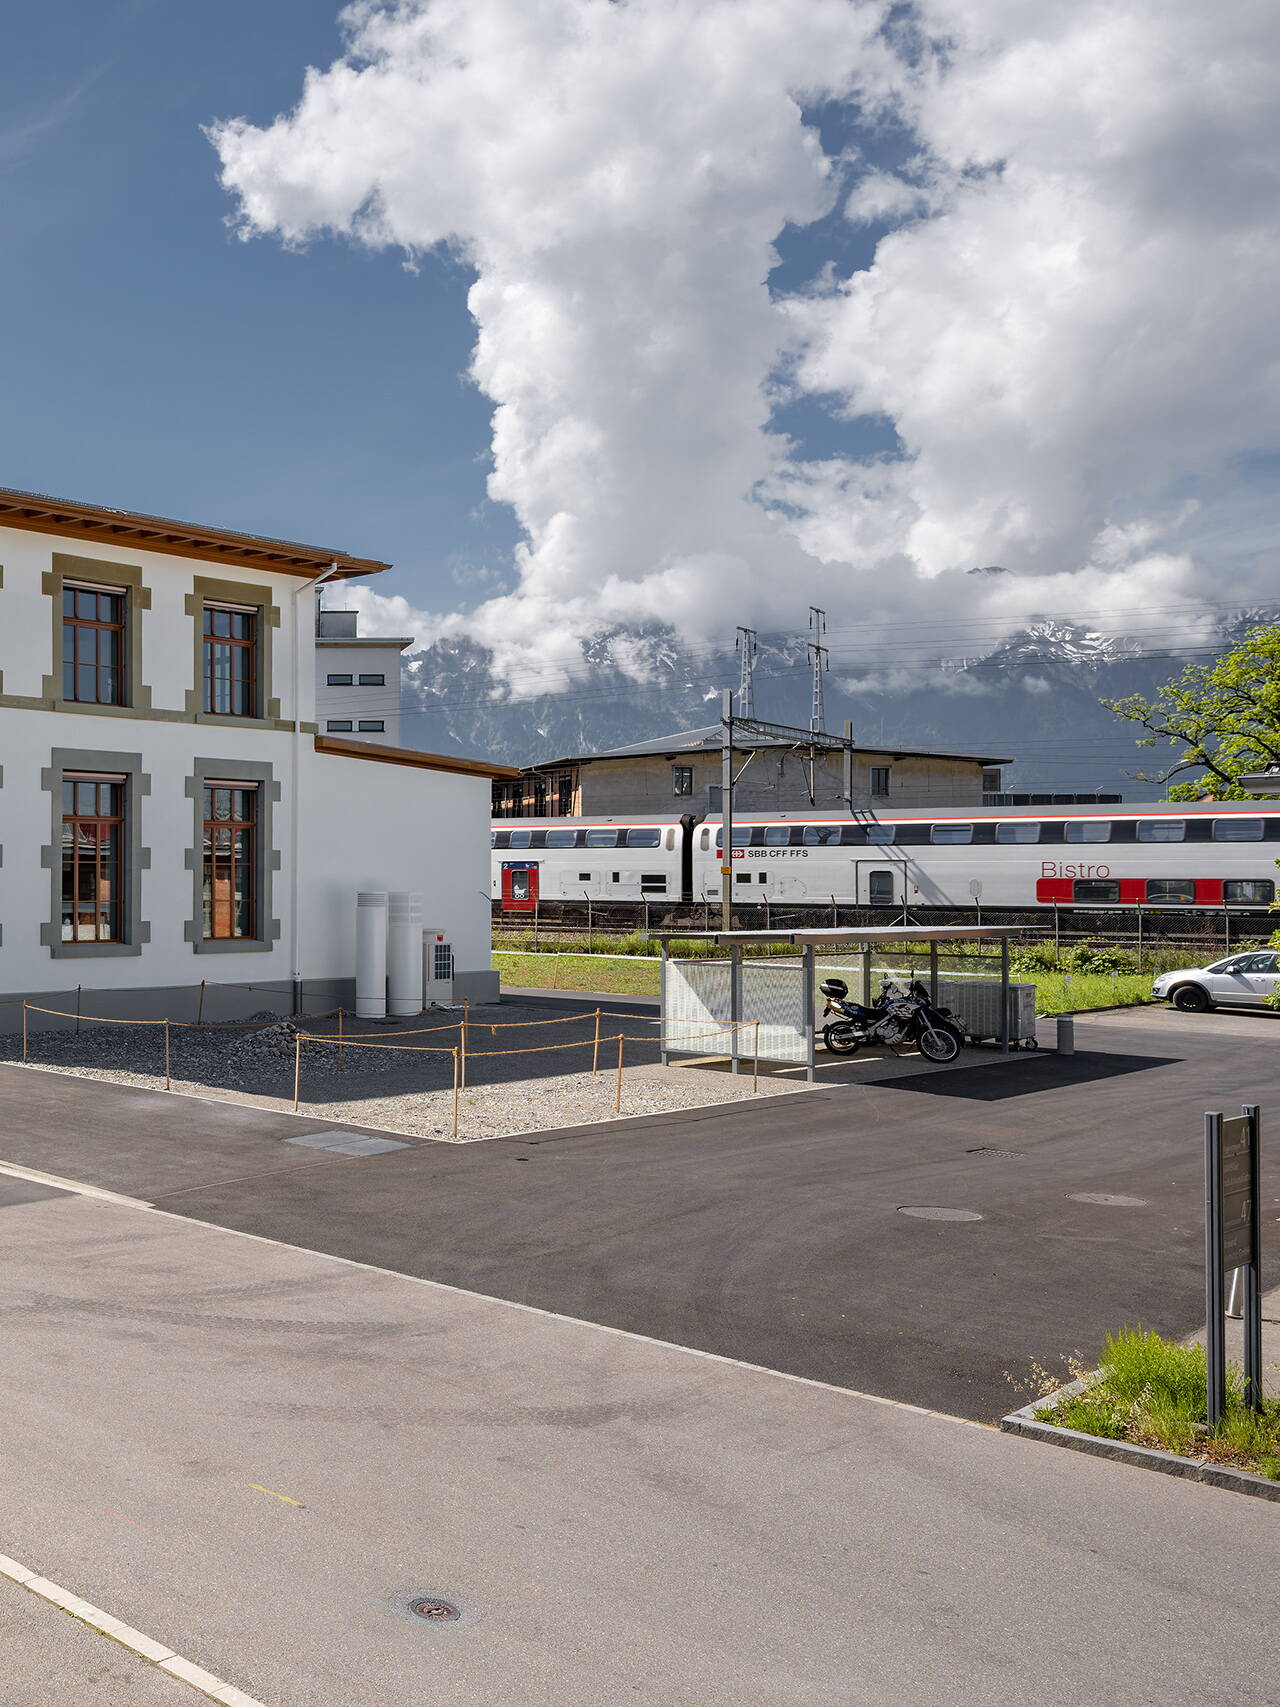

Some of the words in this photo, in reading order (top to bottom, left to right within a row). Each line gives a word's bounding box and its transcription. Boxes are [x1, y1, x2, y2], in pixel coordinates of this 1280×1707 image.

[748, 849, 767, 858] SBB
[769, 849, 788, 858] CFF
[790, 849, 808, 858] FFS
[1041, 861, 1110, 878] Bistro
